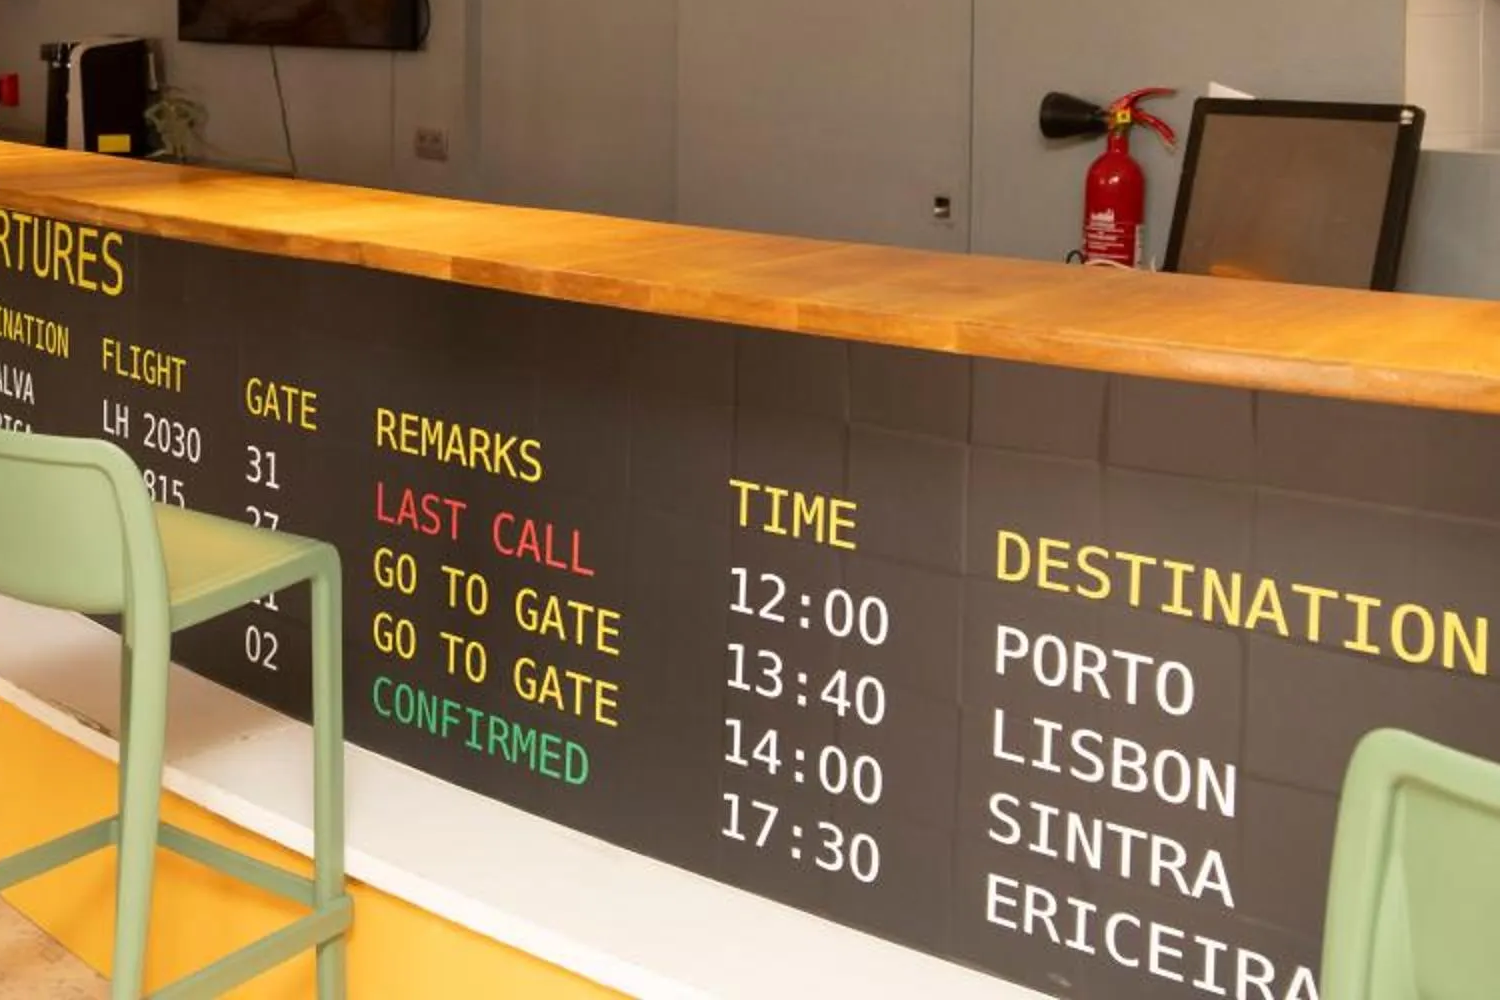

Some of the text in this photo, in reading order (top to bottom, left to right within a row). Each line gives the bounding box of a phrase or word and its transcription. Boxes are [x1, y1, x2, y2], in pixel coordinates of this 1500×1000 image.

[102, 337, 187, 393] FLIGHT
[246, 376, 318, 431] GATE
[376, 407, 542, 483] REMARKS
[102, 399, 129, 439] LH
[143, 412, 202, 464] 2030
[245, 445, 280, 490] 31
[375, 481, 467, 541] LAST
[492, 512, 595, 576] CALL
[373, 547, 417, 595] GO
[440, 564, 489, 617] TO
[514, 587, 622, 657] GATE
[729, 478, 1490, 676] TIME DESTINATION
[729, 566, 1196, 717] 12:00 PORTO
[245, 625, 590, 786] 02 CONFIRMED
[372, 612, 619, 728] GO TO GATE
[726, 642, 1237, 819] 13:40 LISBON
[720, 792, 880, 884] 17:30
[724, 718, 1235, 909] 14:00 SINTRA
